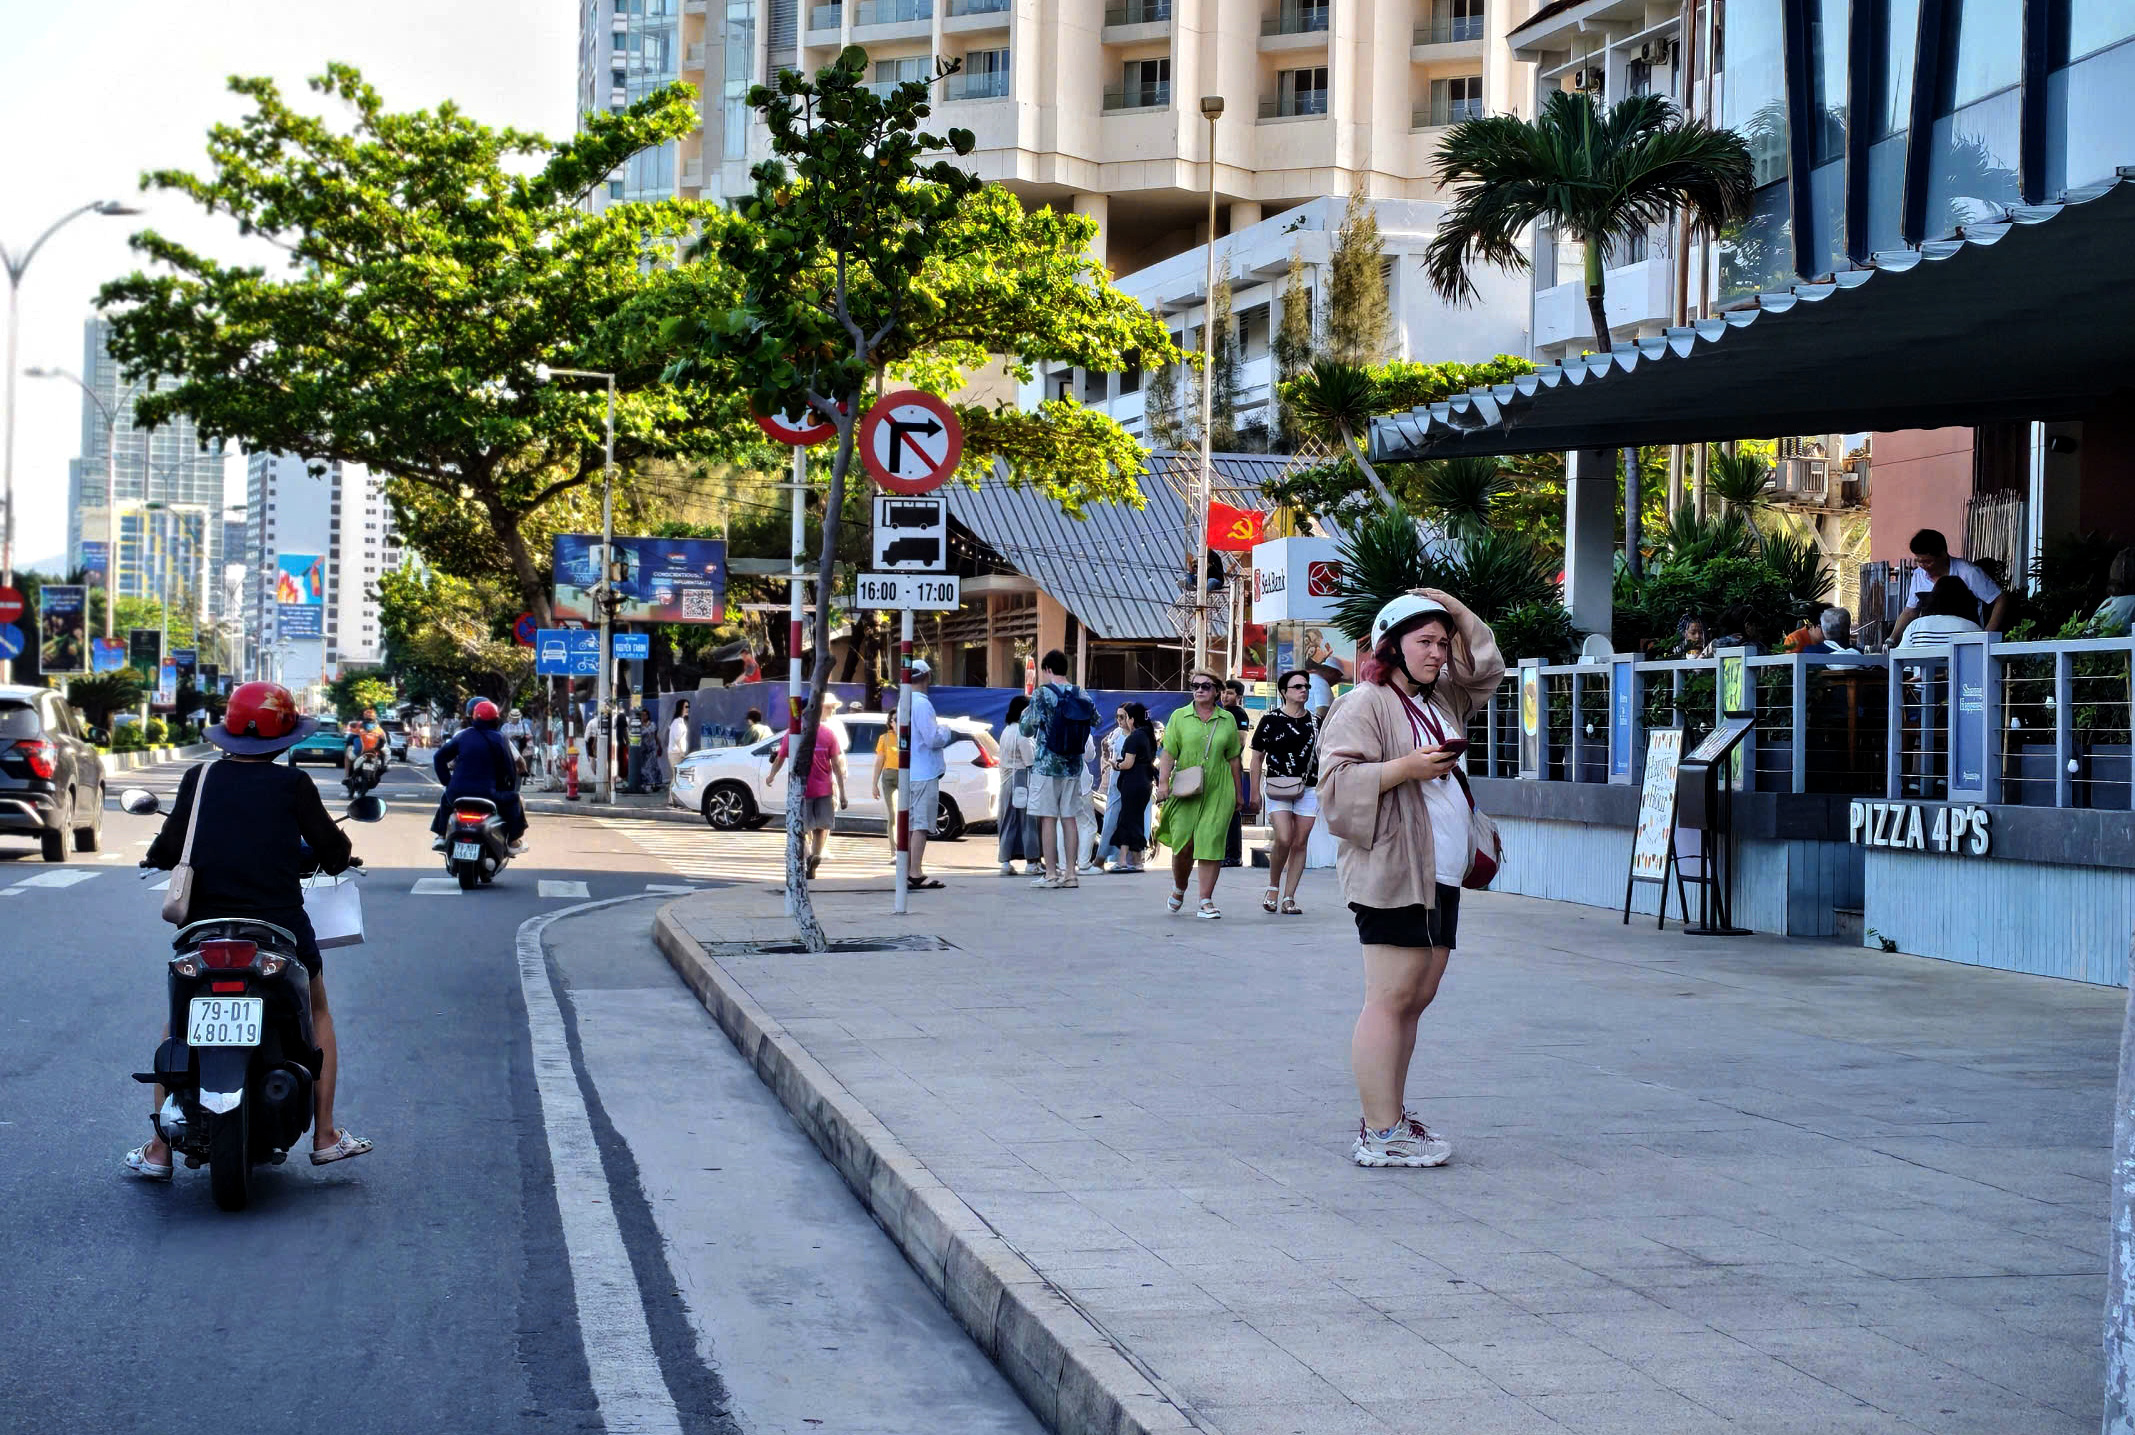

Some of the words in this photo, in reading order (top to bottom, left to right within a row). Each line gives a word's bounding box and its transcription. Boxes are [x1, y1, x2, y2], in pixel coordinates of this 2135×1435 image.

[860, 581, 897, 601] 16:00
[917, 582, 954, 602] 17:00
[1850, 802, 1925, 849] PIZZA
[1931, 805, 1990, 855] 4P'S
[201, 1001, 250, 1021] 79-D1
[193, 1023, 257, 1043] 480.19
